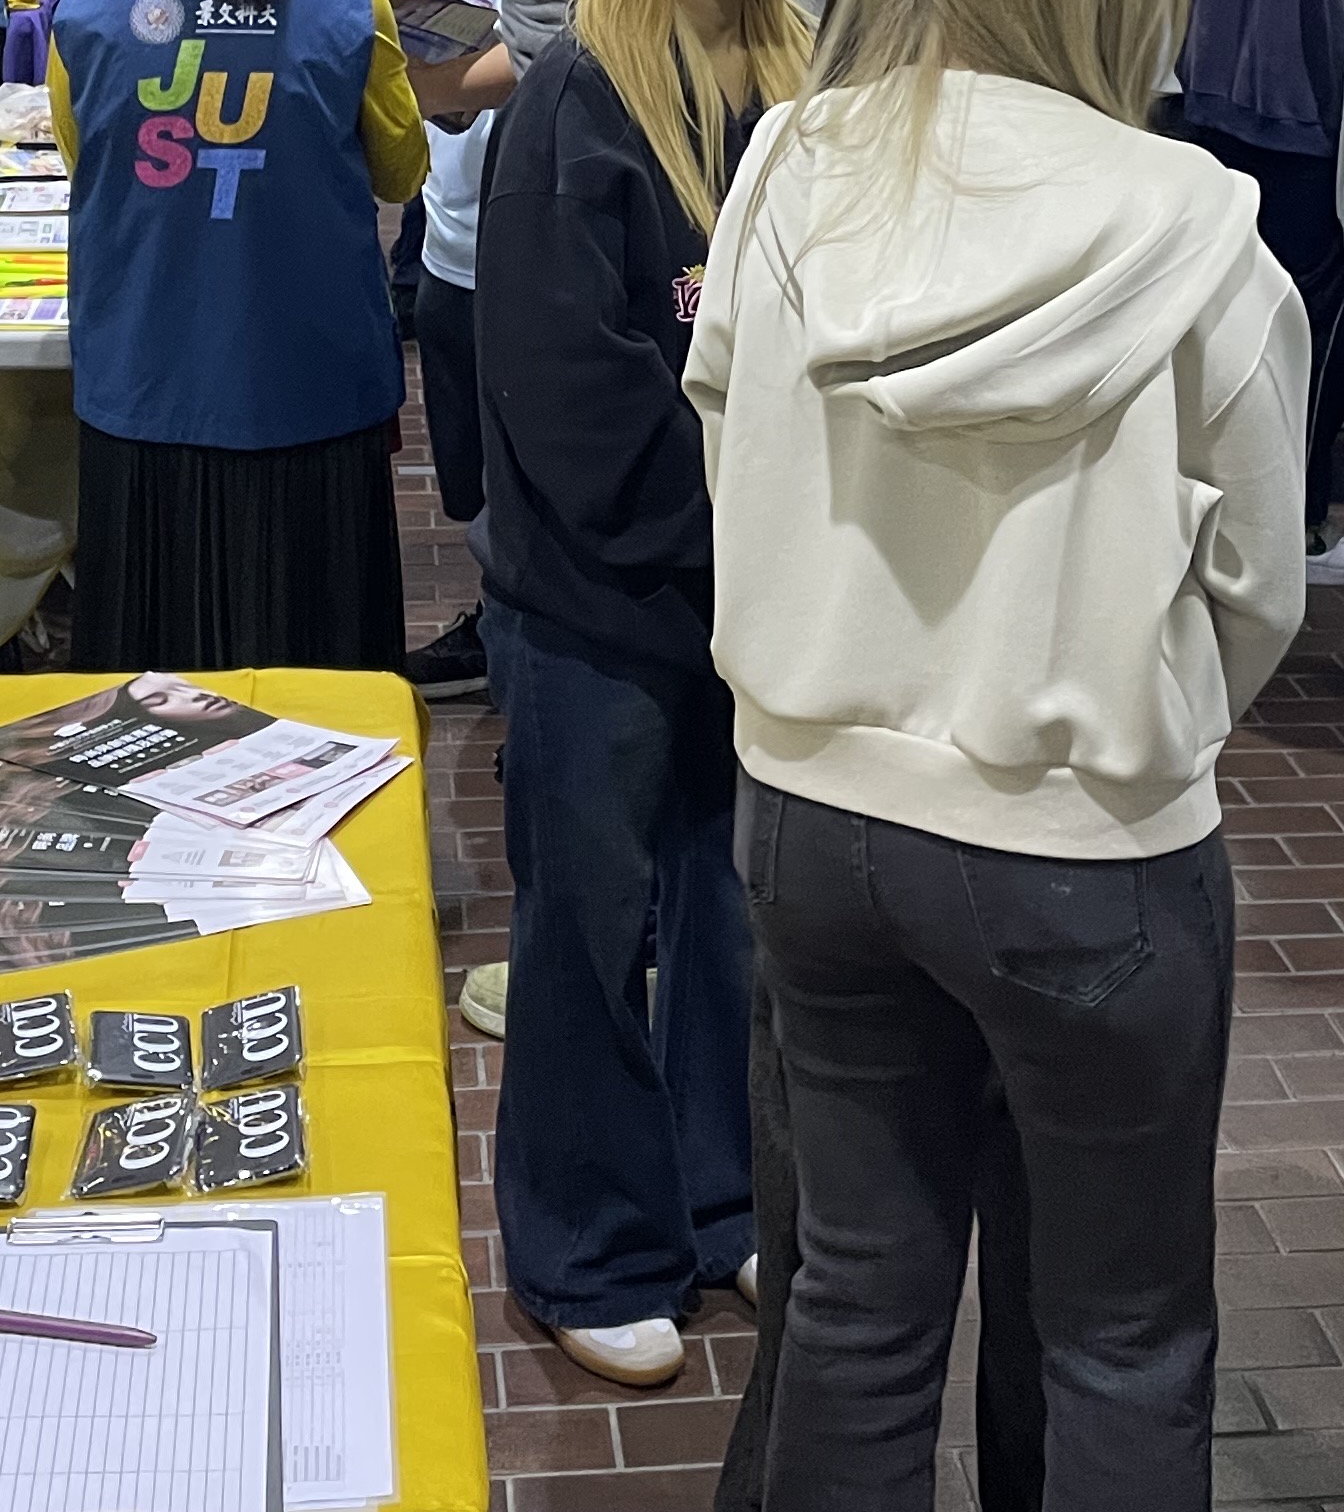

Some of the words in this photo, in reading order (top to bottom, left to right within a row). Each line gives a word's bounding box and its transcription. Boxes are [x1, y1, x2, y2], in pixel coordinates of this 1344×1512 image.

[196, 0, 277, 26] 景文科大
[12, 997, 63, 1058] CCU
[133, 1014, 181, 1072] CCU
[242, 993, 289, 1062] CCU
[119, 1098, 181, 1170] CCU
[238, 1090, 286, 1159] CCU
